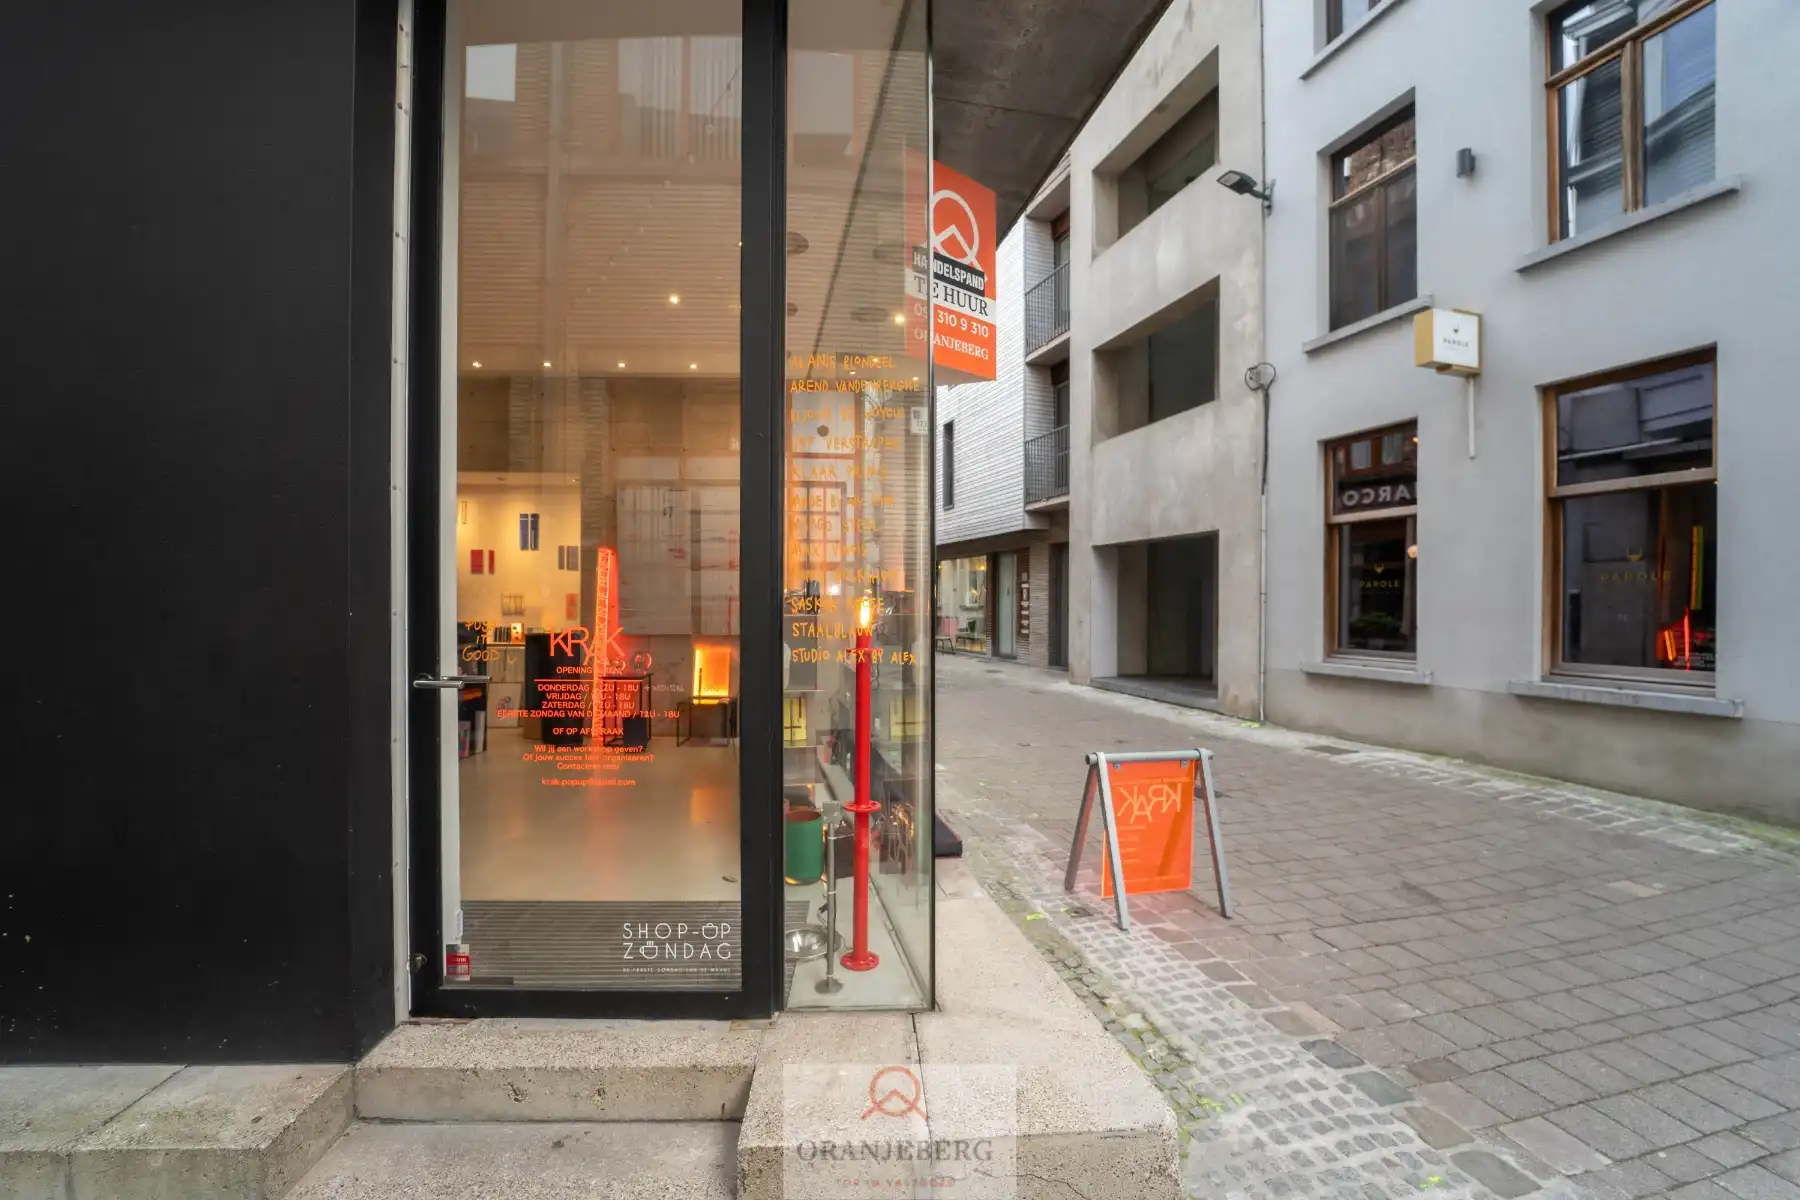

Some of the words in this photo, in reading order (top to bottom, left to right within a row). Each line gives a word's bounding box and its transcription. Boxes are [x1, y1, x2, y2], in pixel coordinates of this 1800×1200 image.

[914, 276, 939, 299] TE
[943, 286, 988, 316] HUUR
[936, 309, 957, 328] 310
[960, 318, 968, 331] 9
[970, 321, 989, 338] 310
[790, 379, 829, 393] AREND
[462, 645, 500, 662] GOOD
[549, 626, 625, 667] KRAK
[791, 648, 830, 663] STUDIO
[891, 651, 918, 666] ALEX
[537, 684, 590, 692] DONDERDAG
[623, 684, 640, 692] 18U
[541, 701, 586, 709] ZATERDAG
[619, 701, 635, 709] 18U
[530, 709, 565, 718] ZONDAG
[567, 709, 585, 718] VAN
[663, 710, 681, 718] 18U
[552, 727, 565, 735] OF
[566, 727, 578, 735] OP
[615, 745, 643, 754] geven?
[622, 922, 731, 939] SHOP-OP
